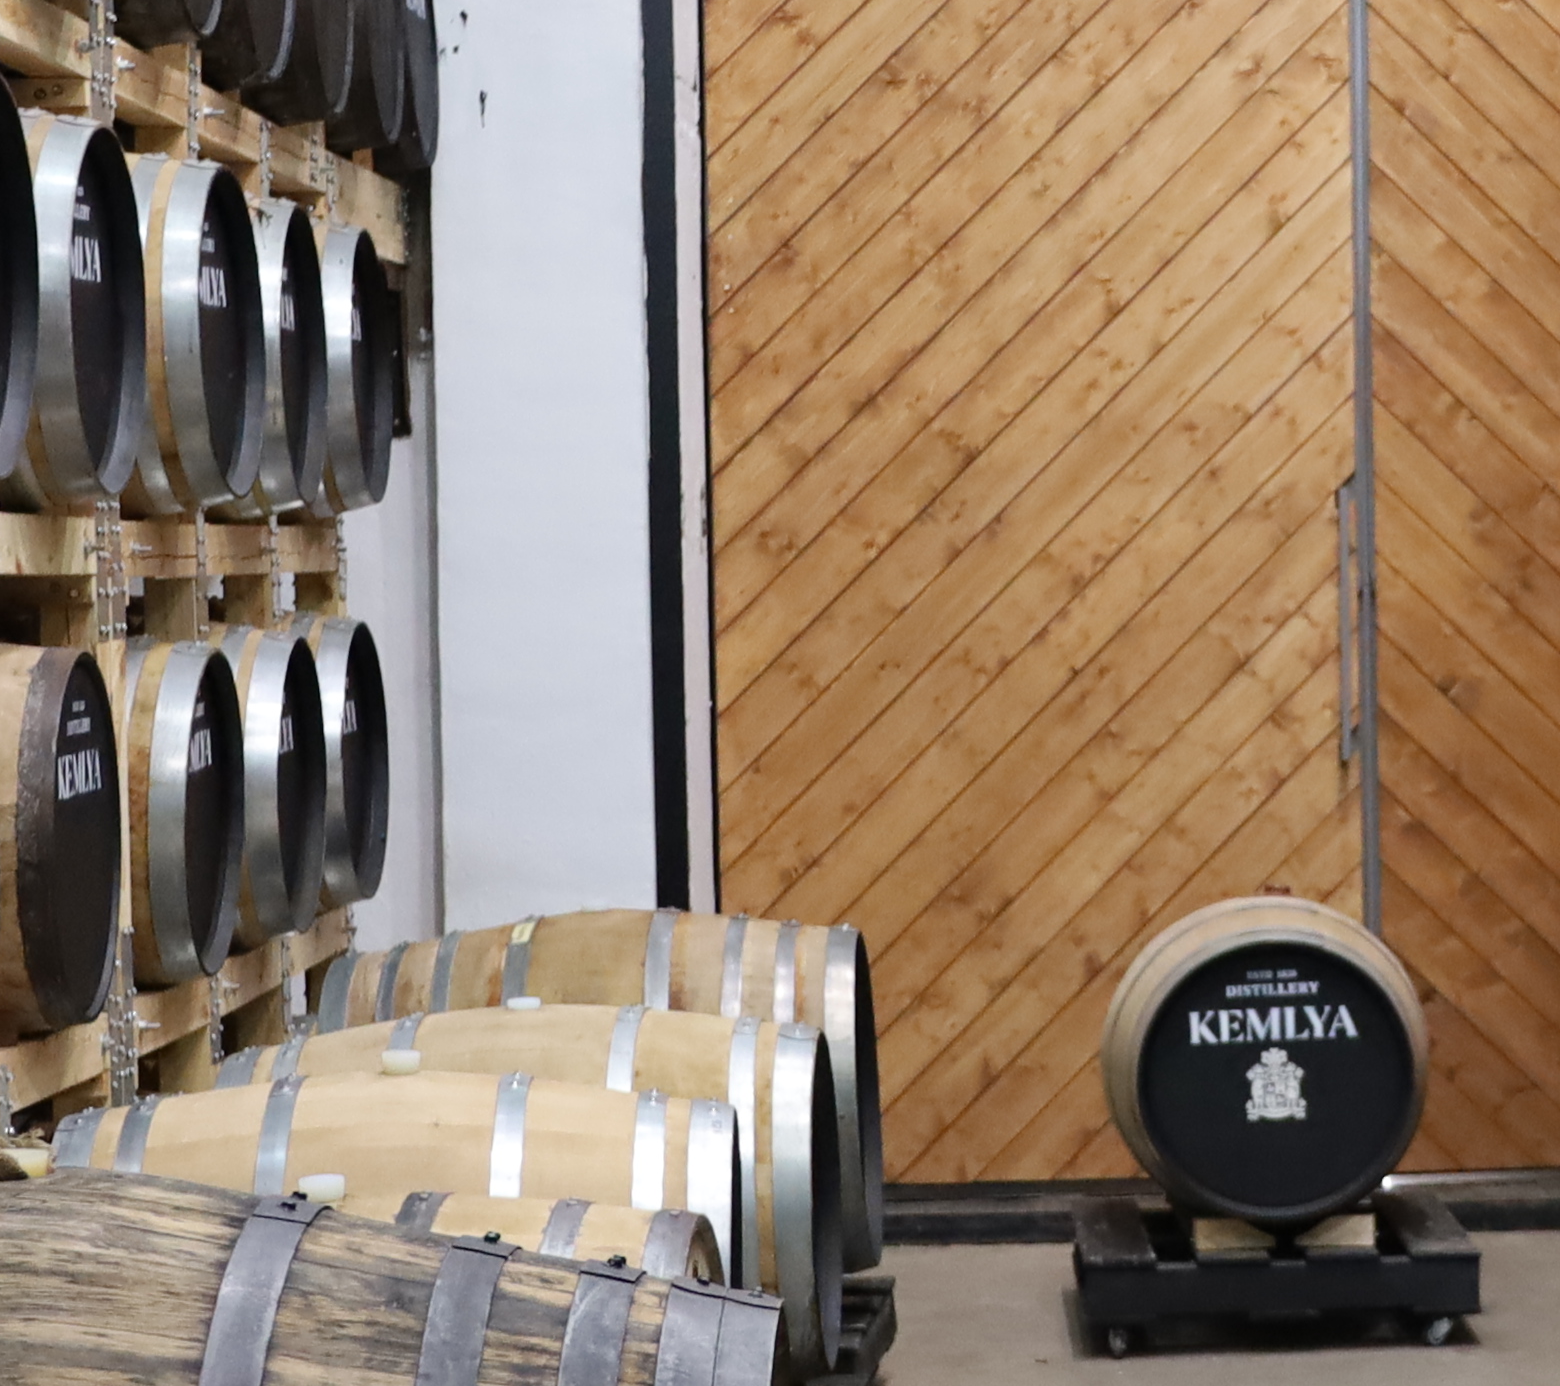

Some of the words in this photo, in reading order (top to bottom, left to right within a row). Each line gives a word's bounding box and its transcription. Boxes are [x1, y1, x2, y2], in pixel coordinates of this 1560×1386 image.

[57, 747, 102, 801] KEMLYA
[1226, 981, 1320, 999] DISTILLERY
[1189, 1004, 1359, 1046] KEMLYA
